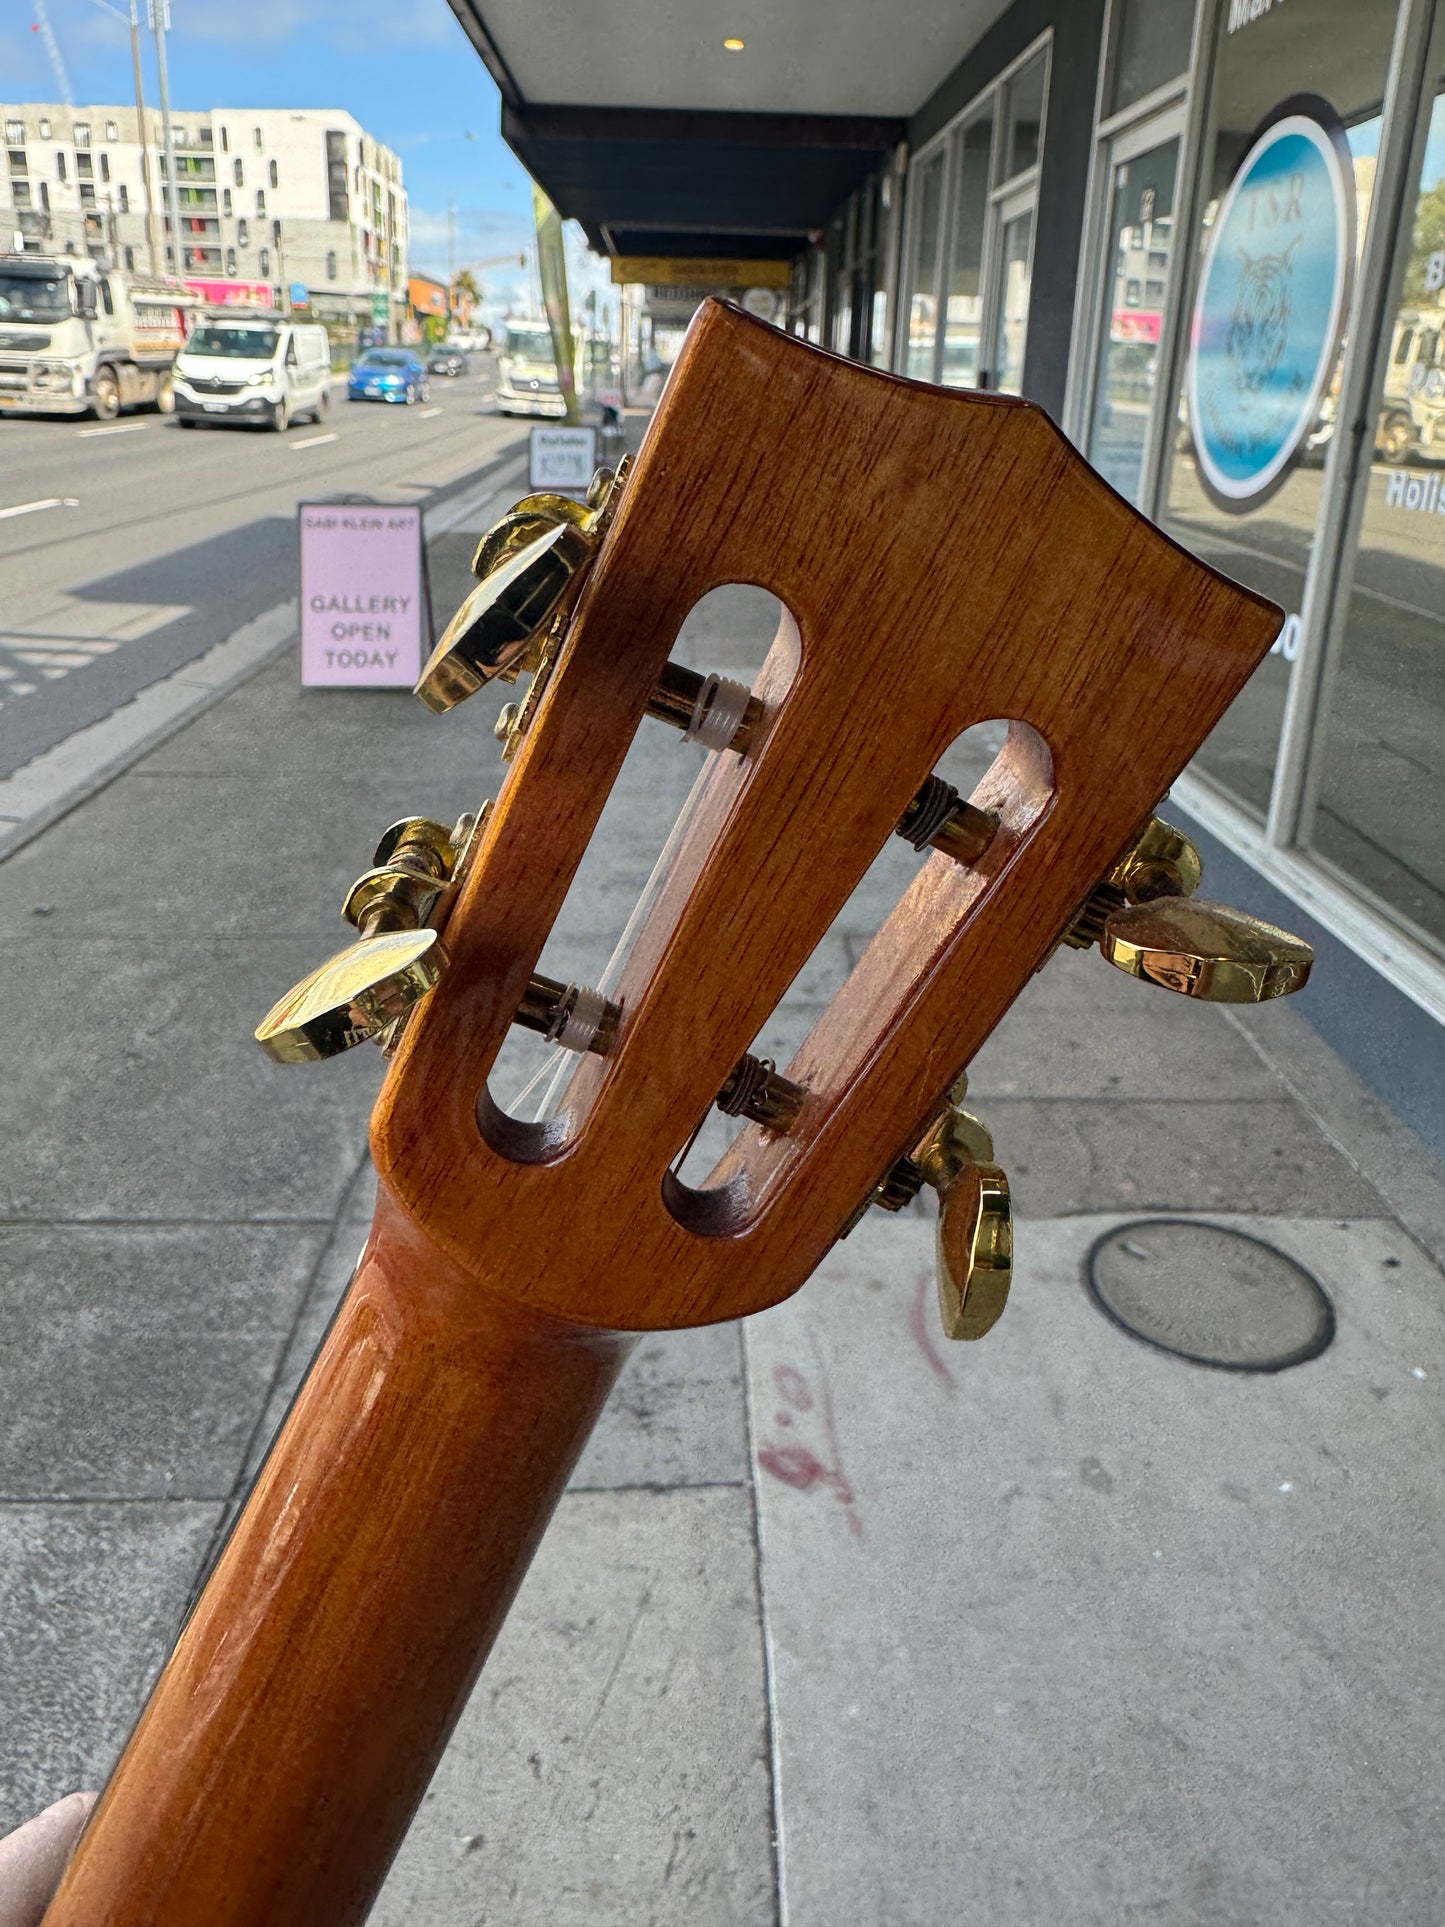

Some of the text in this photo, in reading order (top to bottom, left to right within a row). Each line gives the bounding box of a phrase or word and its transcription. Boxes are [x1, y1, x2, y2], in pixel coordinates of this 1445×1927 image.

[310, 594, 411, 613] GALLERY
[330, 622, 391, 641] OPEN
[324, 649, 398, 669] TODAY
